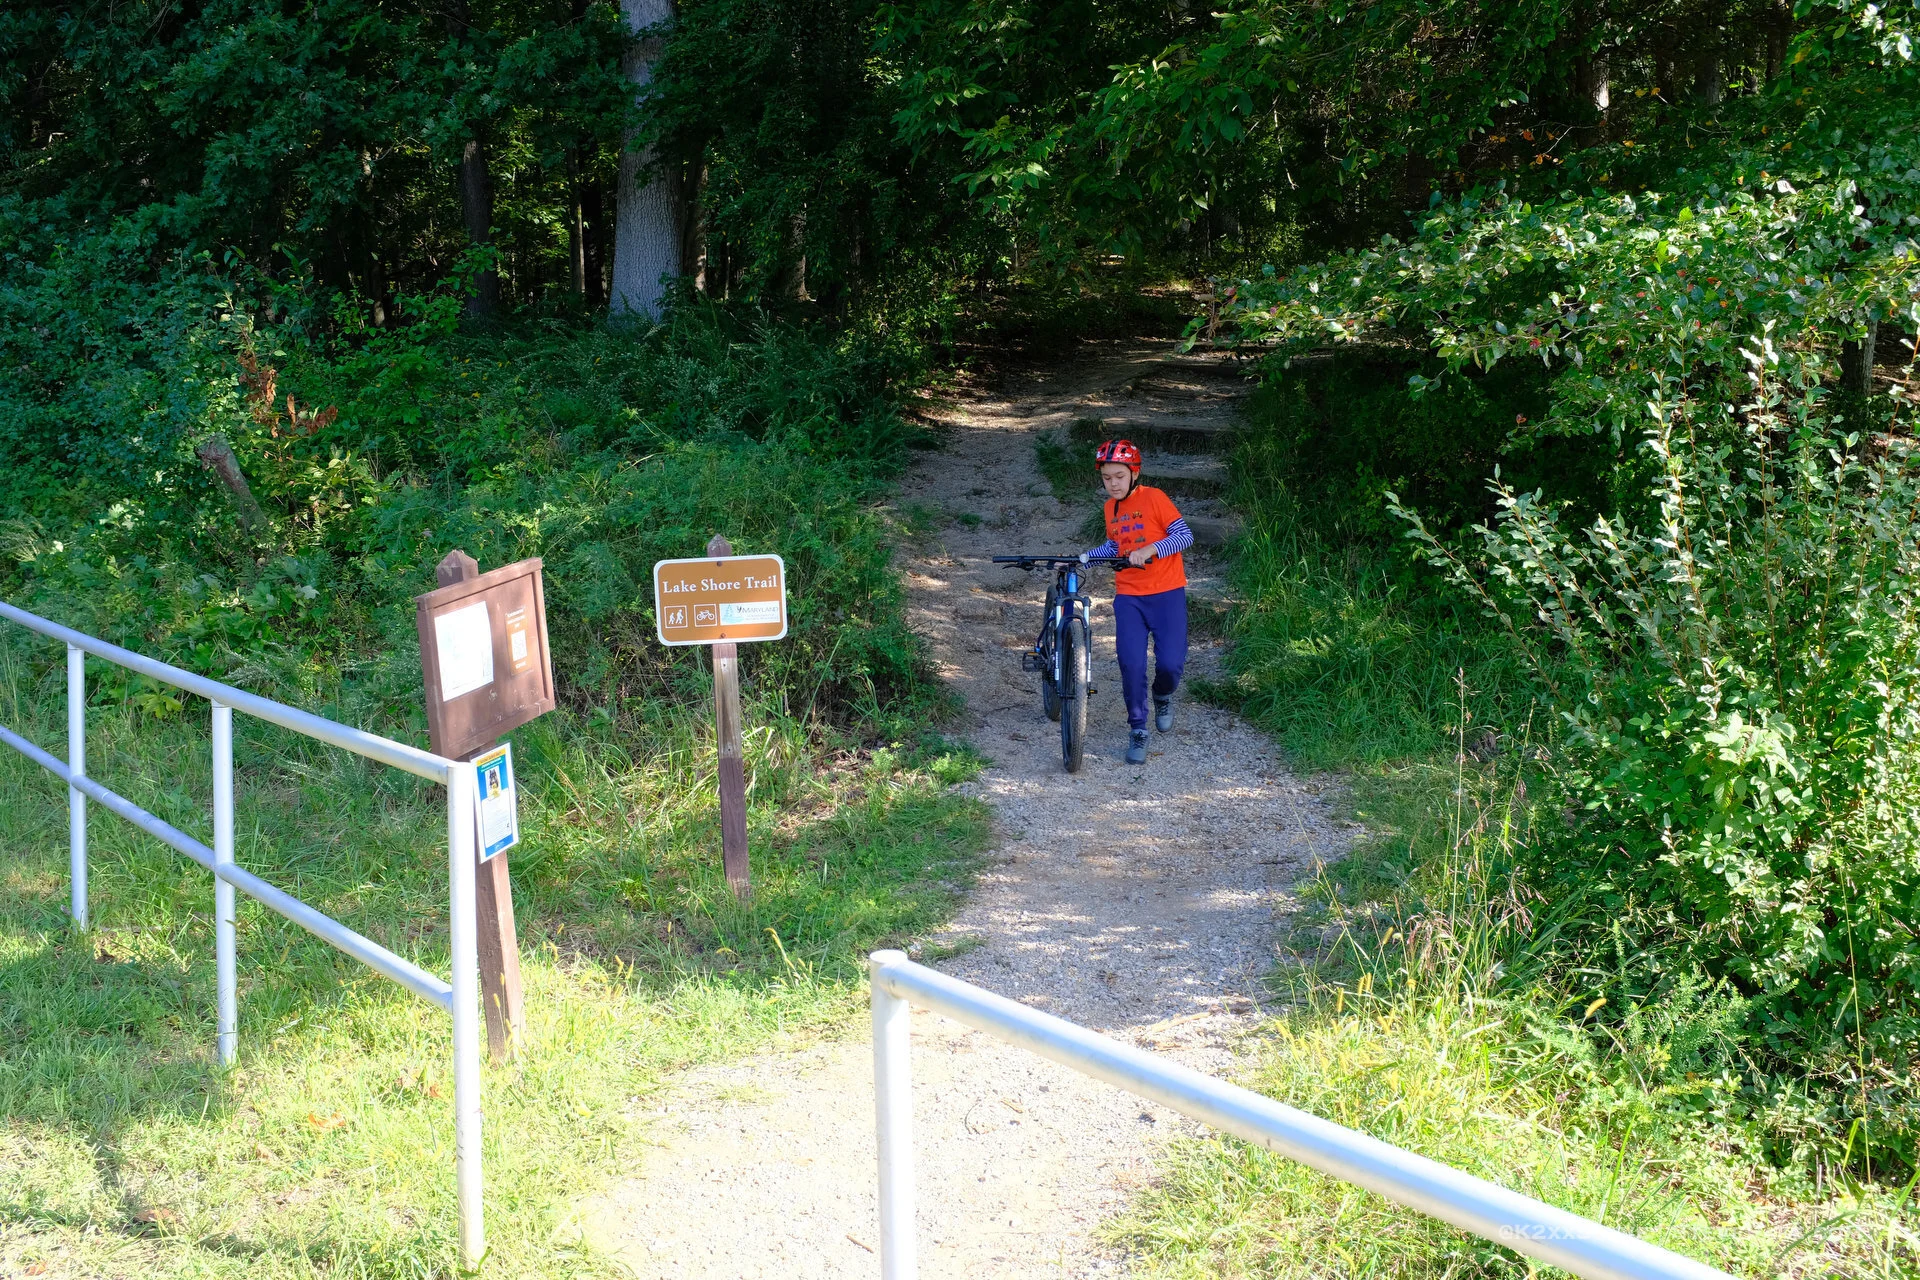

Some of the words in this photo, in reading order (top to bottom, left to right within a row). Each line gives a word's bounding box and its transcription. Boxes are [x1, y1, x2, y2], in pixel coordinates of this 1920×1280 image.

[663, 580, 697, 593] Lake
[700, 577, 741, 591] Shore
[744, 575, 778, 589] Trail
